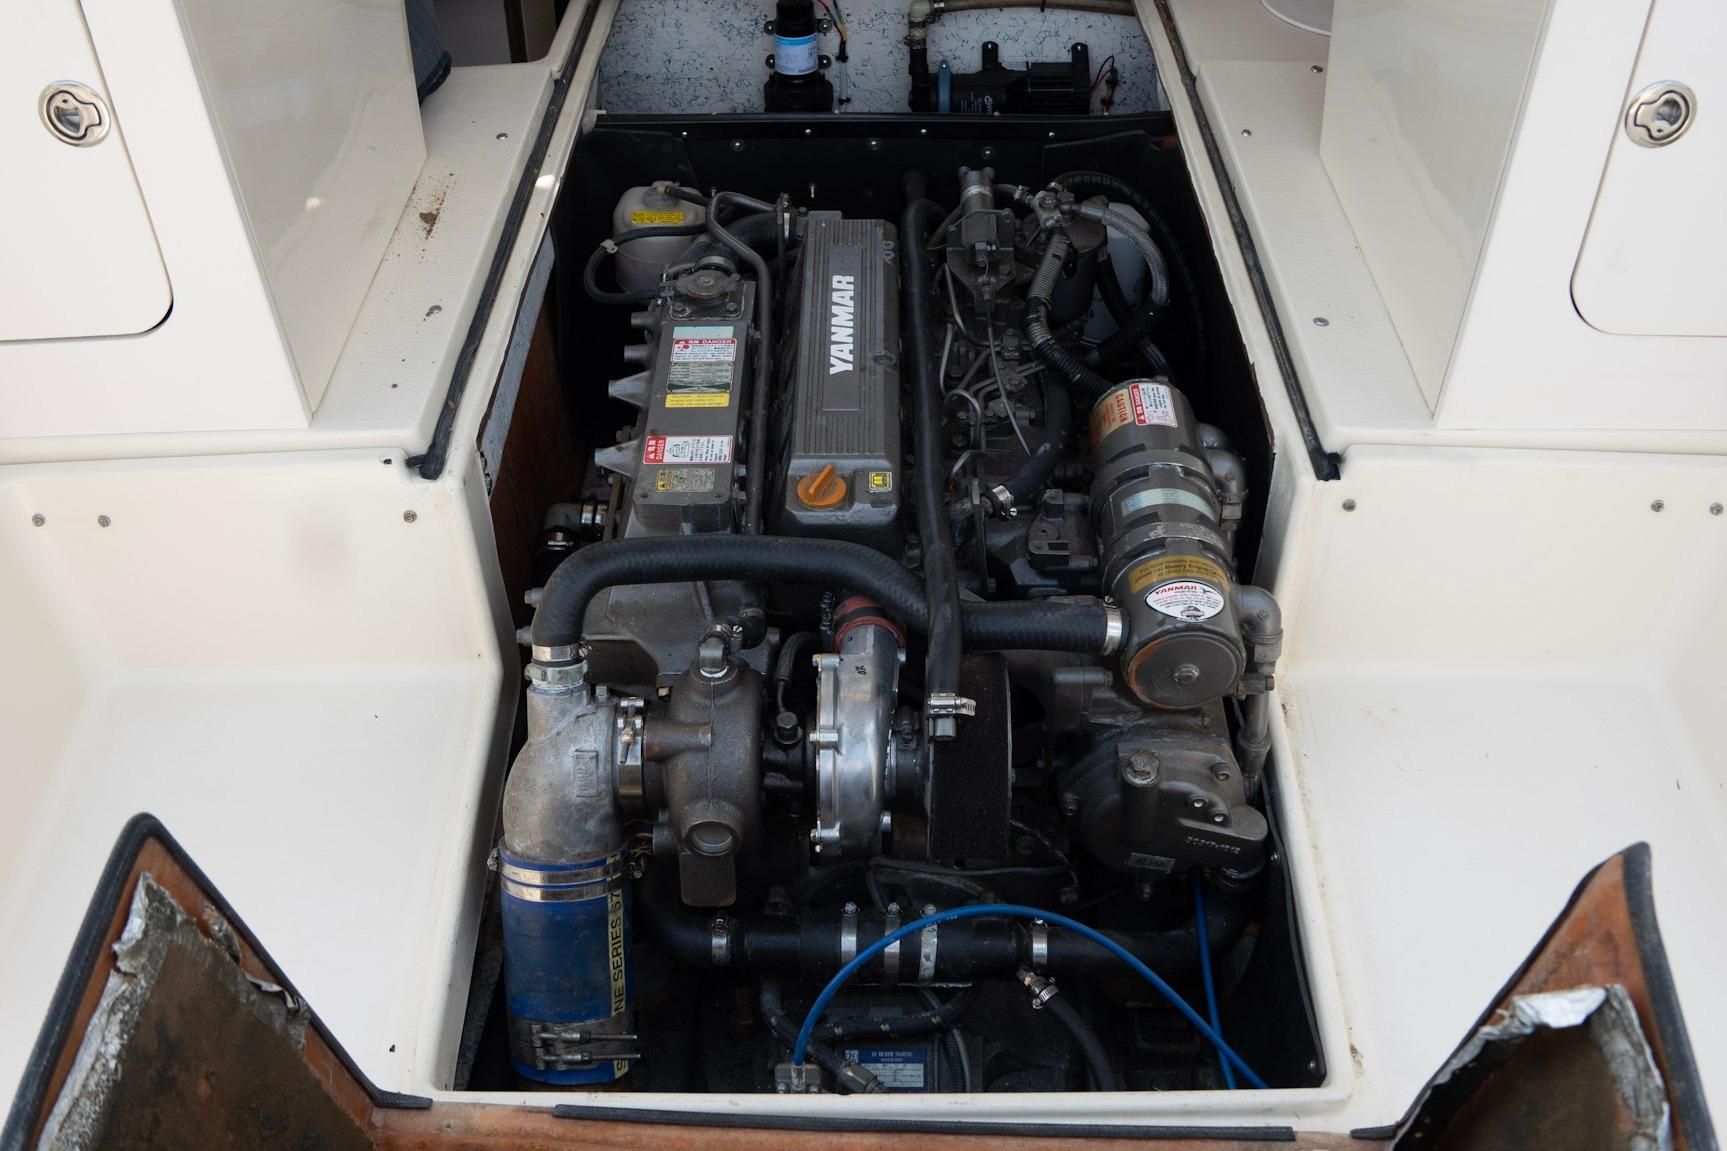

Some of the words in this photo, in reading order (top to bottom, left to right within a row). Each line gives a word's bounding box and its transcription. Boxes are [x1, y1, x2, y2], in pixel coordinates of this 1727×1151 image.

[829, 275, 855, 375] YANMAR
[1115, 393, 1128, 423] CAUTION
[655, 439, 665, 460] DANGER
[1155, 585, 1198, 595] YANMAR
[611, 916, 624, 981] SERIES
